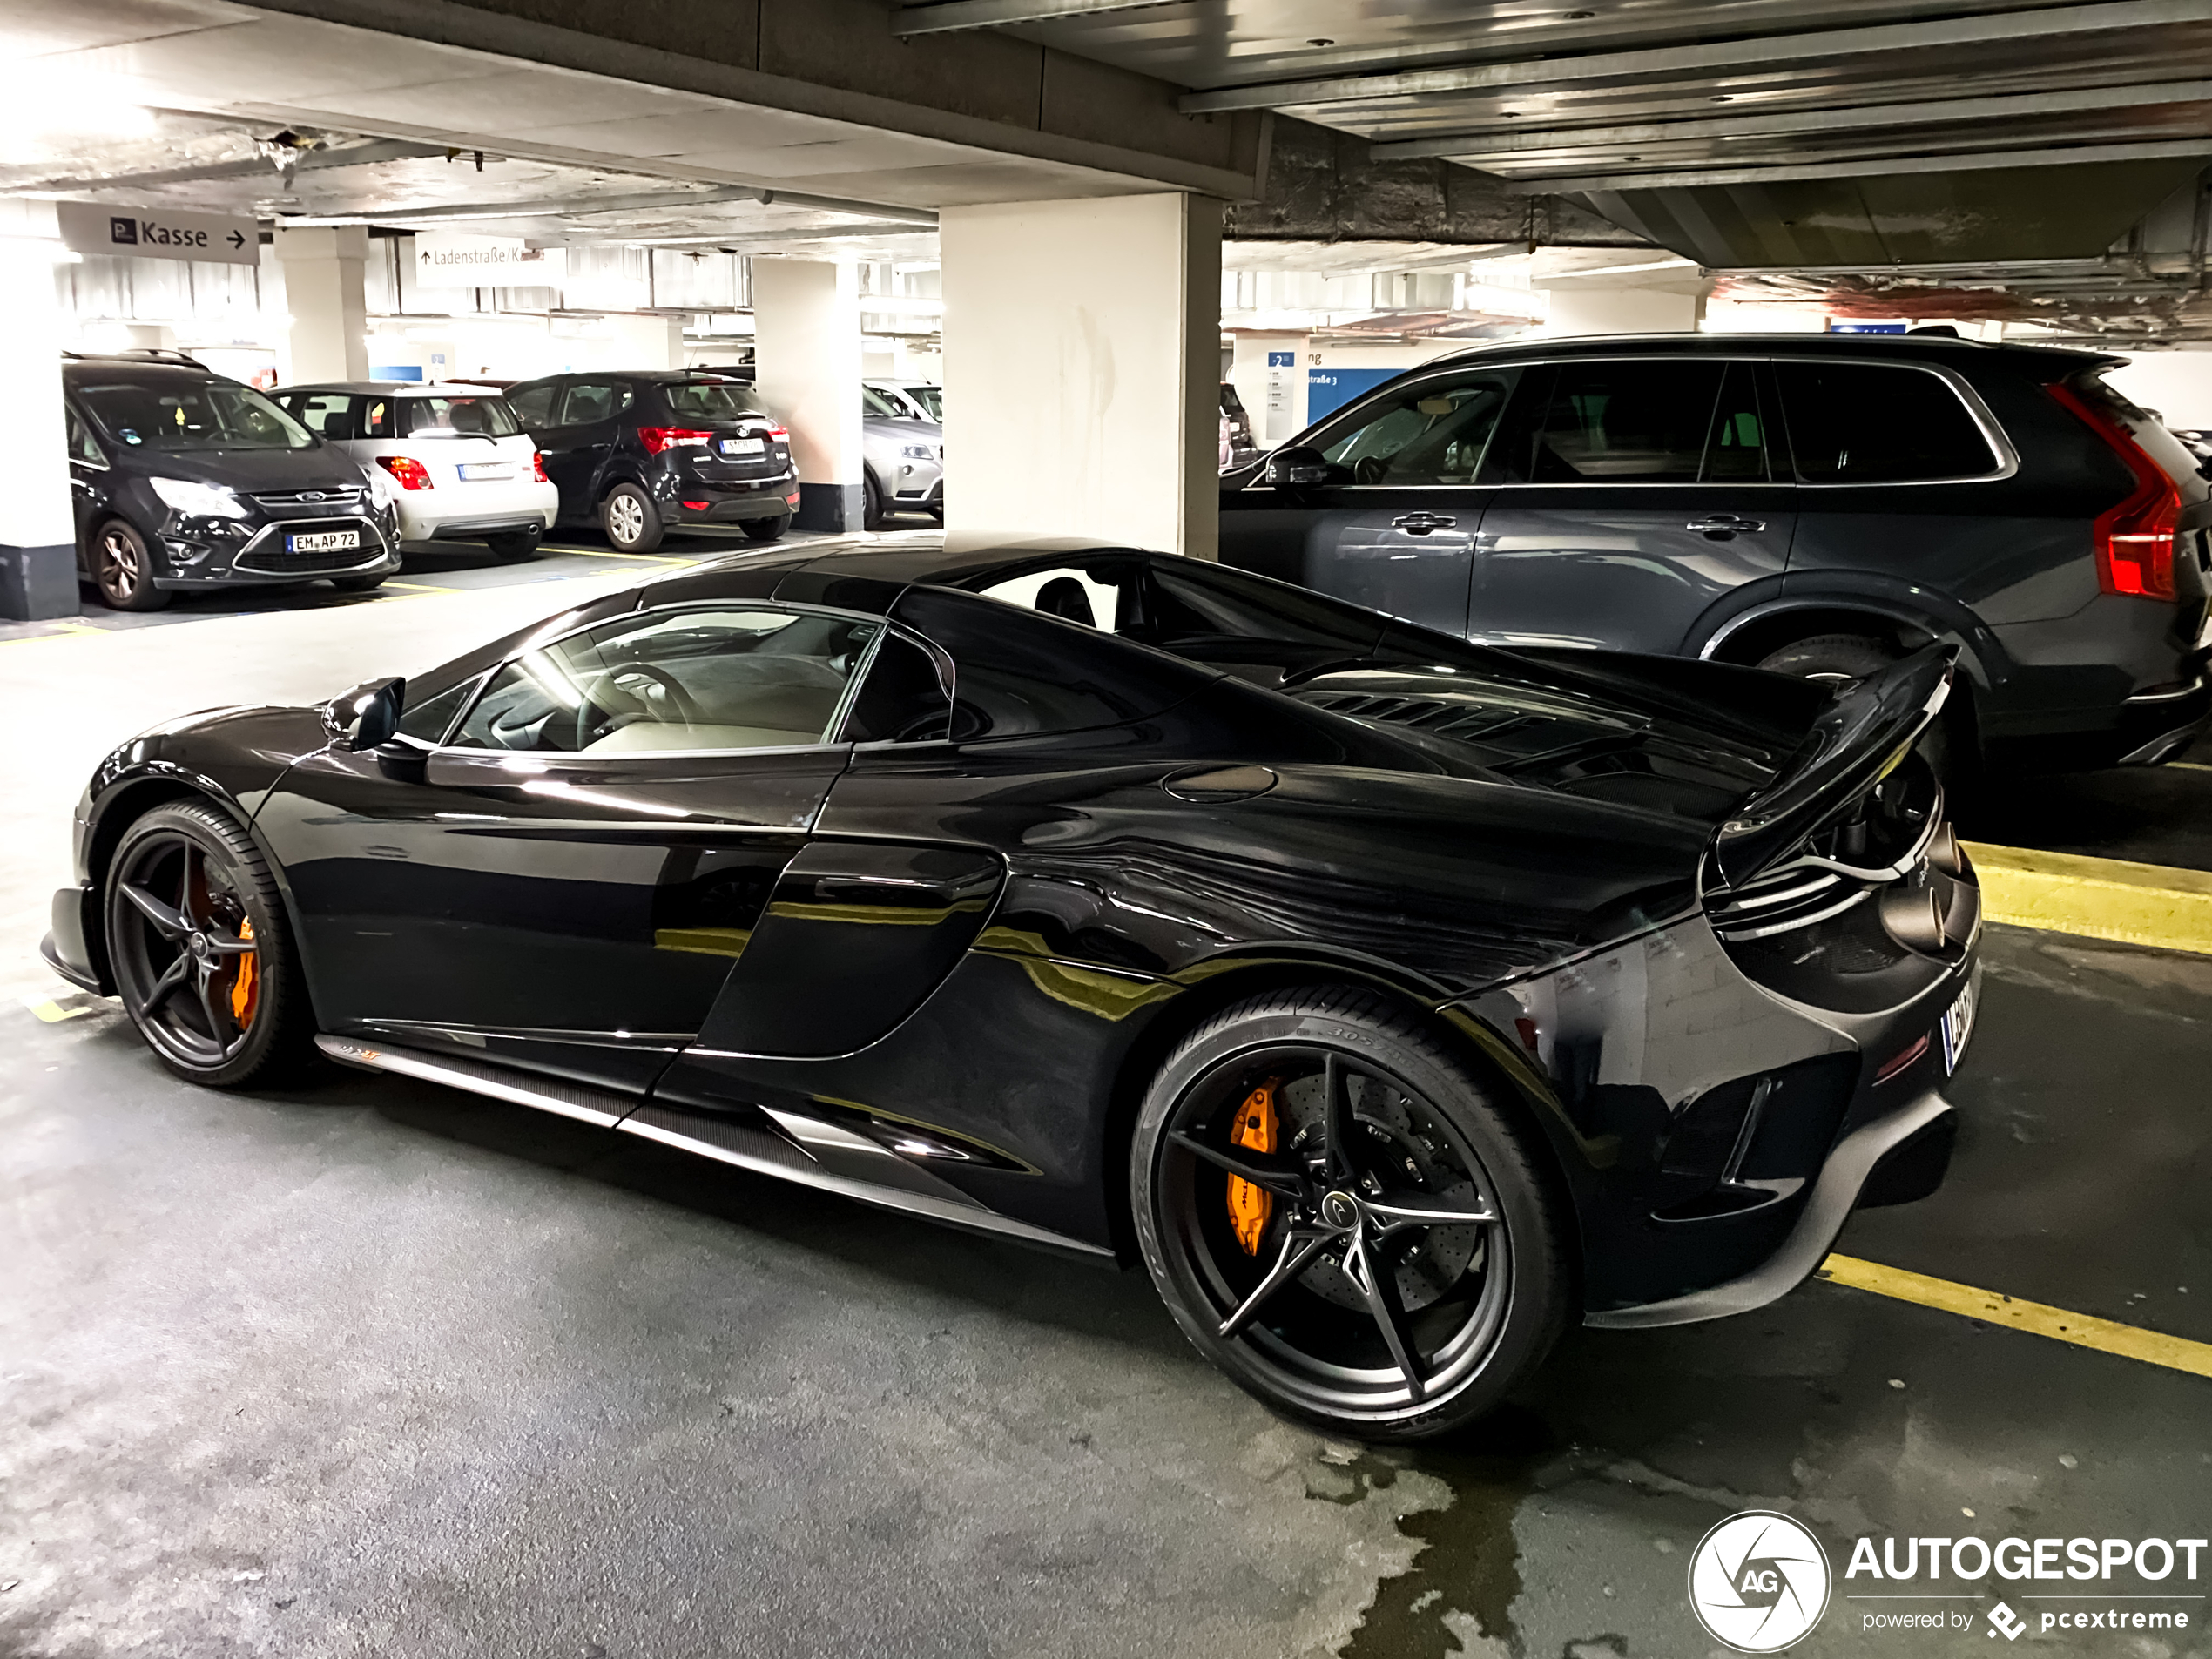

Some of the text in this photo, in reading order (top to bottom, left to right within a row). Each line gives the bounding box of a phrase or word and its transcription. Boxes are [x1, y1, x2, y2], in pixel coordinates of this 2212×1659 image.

[141, 220, 208, 247] Kasse
[1332, 376, 1338, 386] 3
[296, 533, 355, 550] EM AP 72
